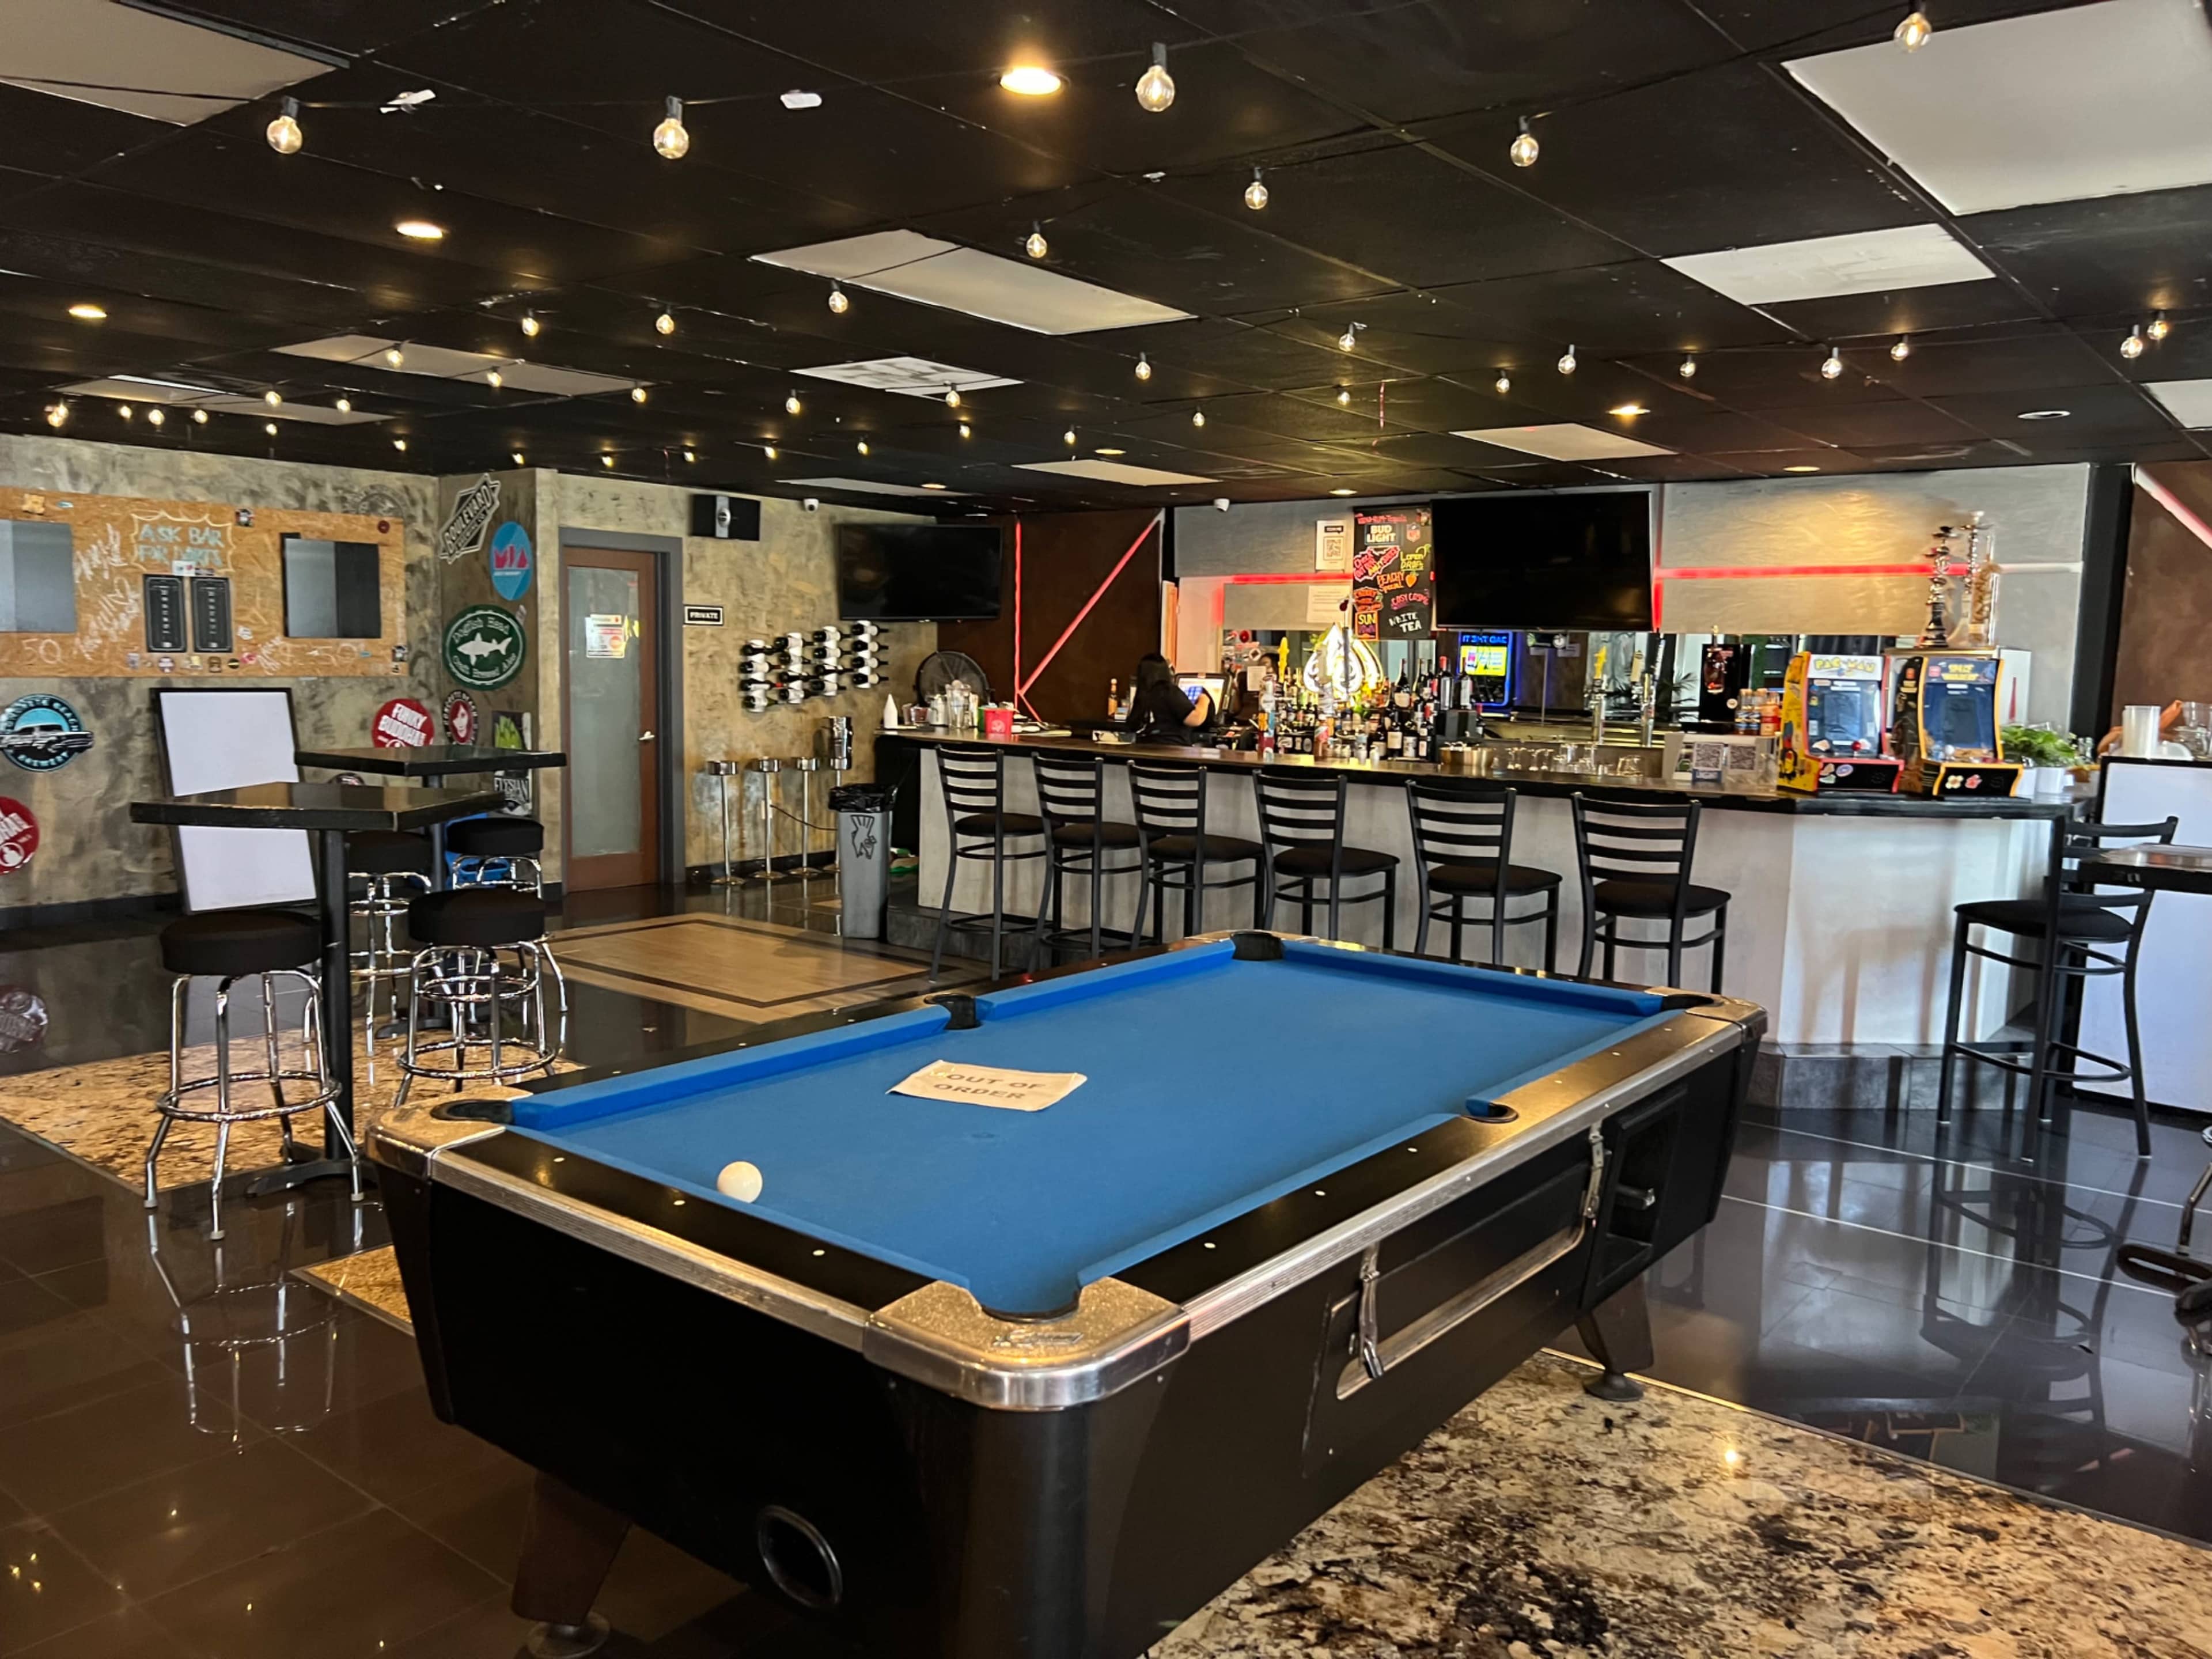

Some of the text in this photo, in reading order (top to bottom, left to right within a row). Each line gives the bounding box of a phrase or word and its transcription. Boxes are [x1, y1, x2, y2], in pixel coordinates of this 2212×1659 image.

[444, 485, 492, 554] BOULEVARD
[139, 523, 226, 548] ASK BAR
[1370, 525, 1392, 534] BUD
[1366, 533, 1397, 543] LIGHT
[494, 544, 528, 569] MIA
[1376, 571, 1404, 587] PEACHY
[690, 611, 719, 620] PRIVATE
[1358, 613, 1376, 626] SUN
[1388, 612, 1418, 626] WHITE
[1399, 620, 1422, 633] TEA
[1815, 657, 1876, 673] PAC-MAN
[946, 1073, 1046, 1090] OUT OF
[933, 1084, 1026, 1099] ORDER
